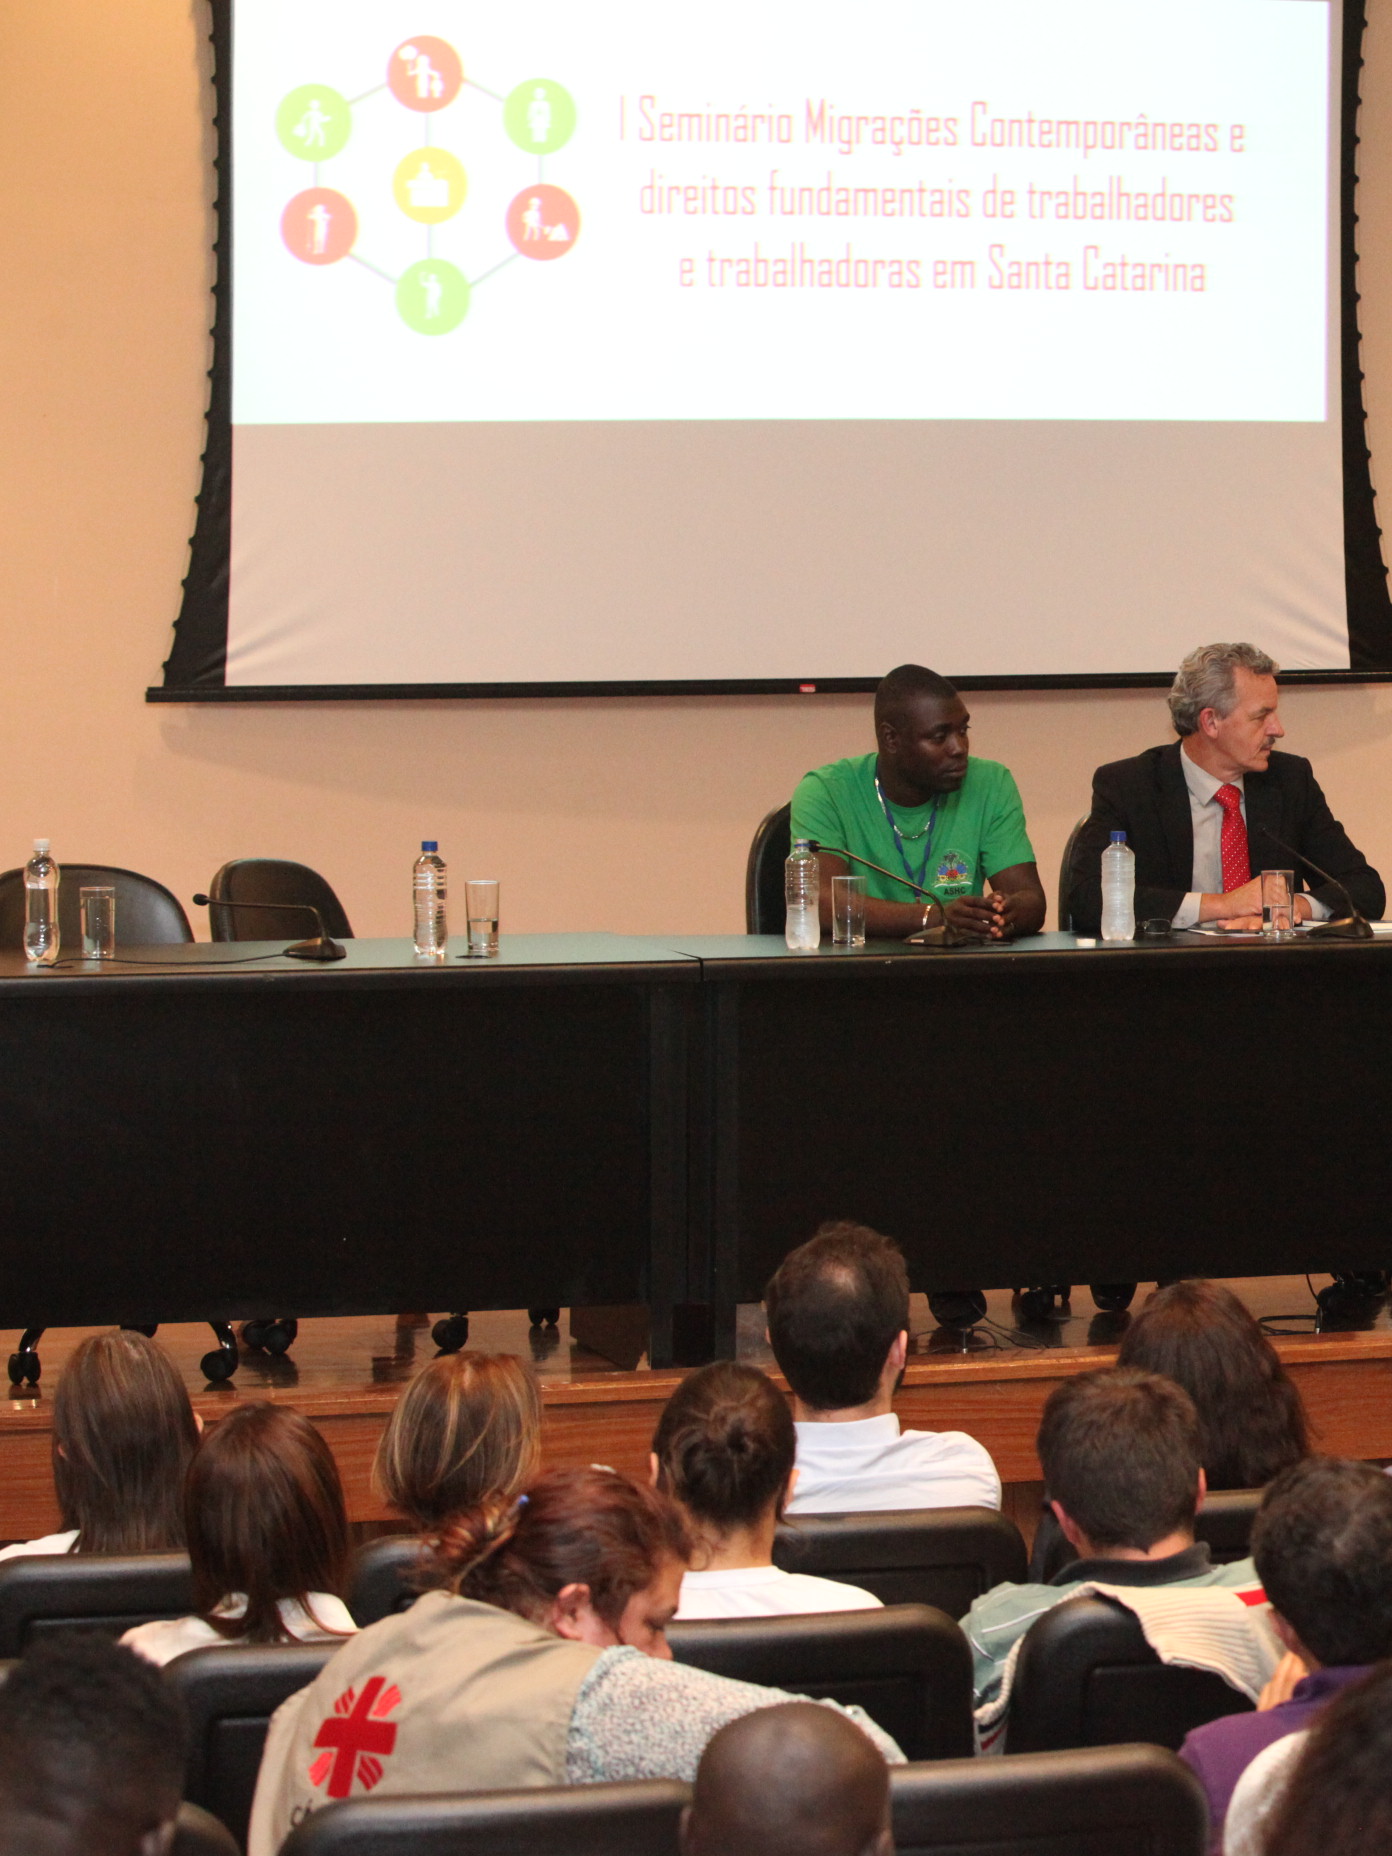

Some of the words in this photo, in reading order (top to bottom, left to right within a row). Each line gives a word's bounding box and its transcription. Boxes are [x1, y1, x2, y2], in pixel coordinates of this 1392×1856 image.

[619, 95, 625, 142] I
[638, 94, 794, 145] Seminário
[804, 97, 959, 156] Migrações
[970, 100, 1220, 160] Contemporâneas
[1229, 123, 1246, 153] e
[639, 167, 757, 216] direitos
[768, 168, 972, 218] fundamentais
[982, 172, 1016, 219] de
[1027, 173, 1235, 224] trabalhadores
[679, 257, 695, 288] e
[706, 240, 922, 290] trabalhadoras
[932, 259, 976, 290] em
[988, 242, 1072, 291] Santa
[1082, 244, 1208, 293] Catarina
[943, 887, 967, 895] ASHC
